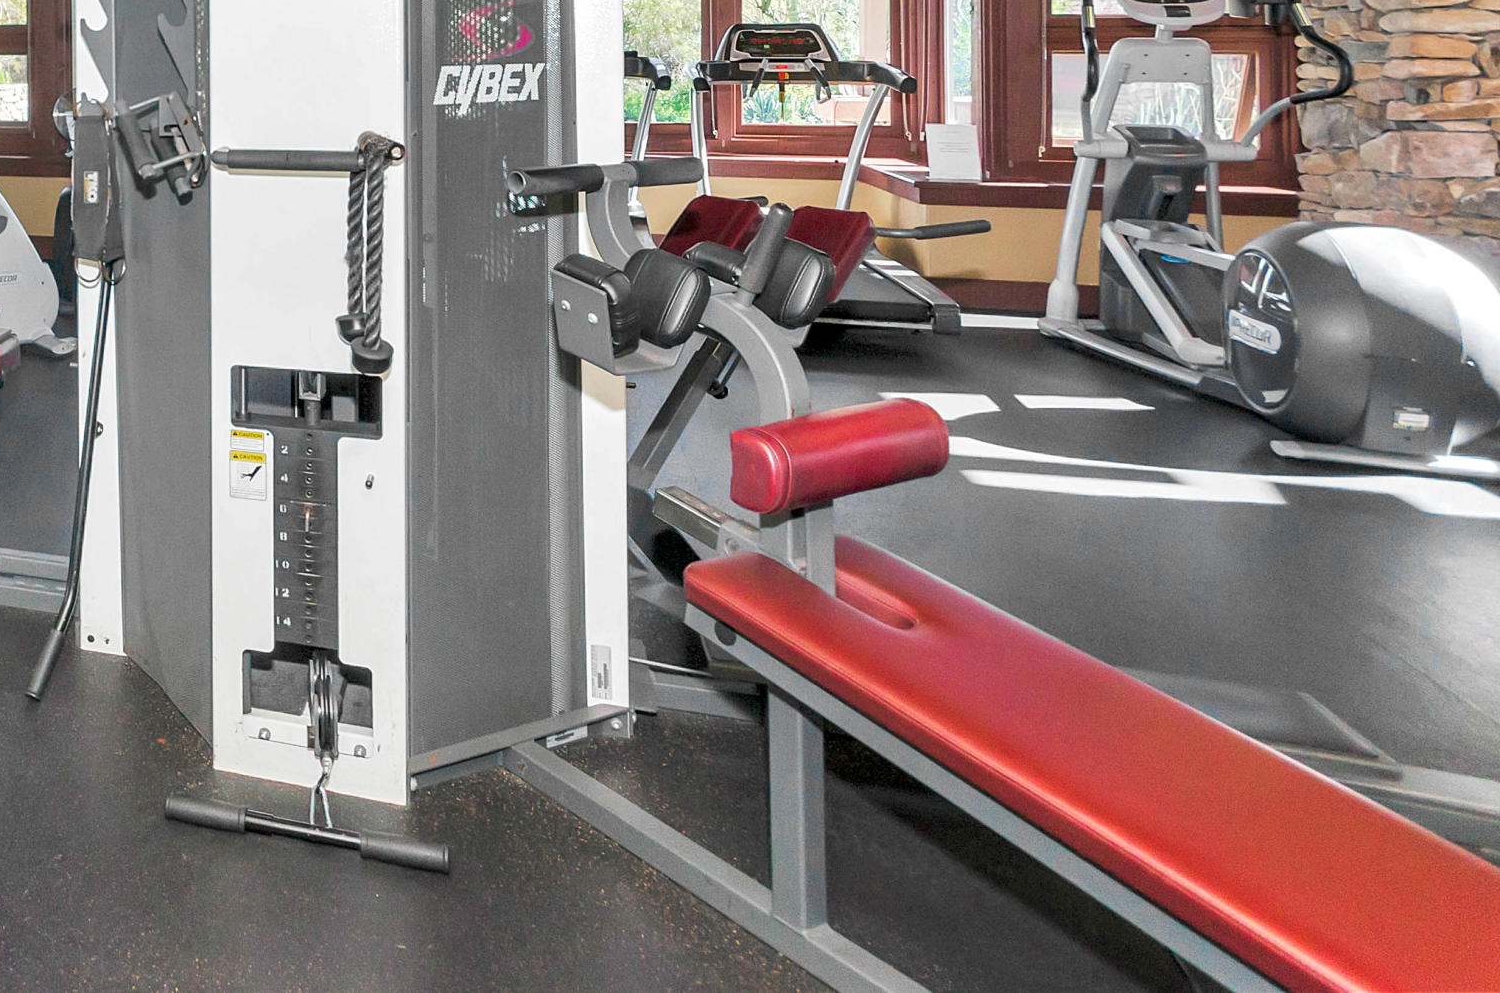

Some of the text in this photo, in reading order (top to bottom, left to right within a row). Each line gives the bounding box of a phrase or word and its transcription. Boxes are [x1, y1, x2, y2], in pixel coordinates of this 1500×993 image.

[433, 63, 545, 116] CYBEX
[281, 445, 289, 455] 2
[280, 473, 288, 483] 4
[275, 587, 290, 598] 12
[276, 616, 292, 626] 14
